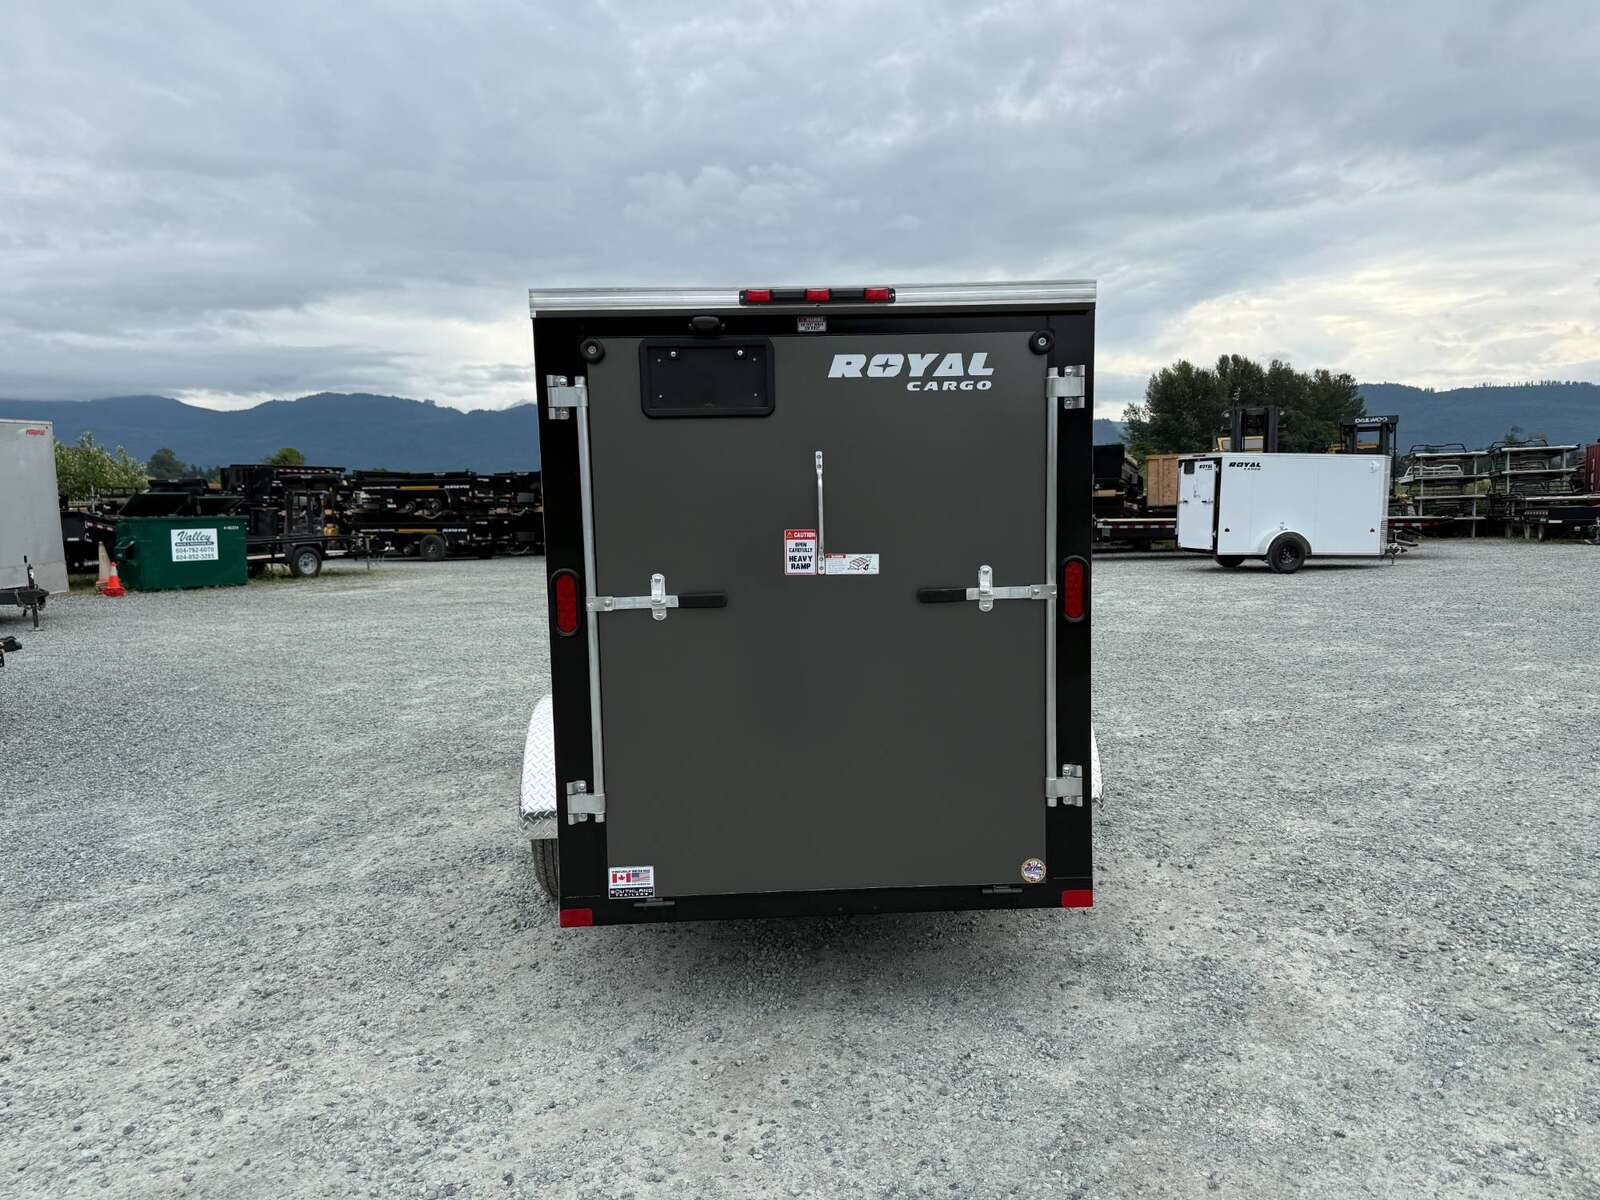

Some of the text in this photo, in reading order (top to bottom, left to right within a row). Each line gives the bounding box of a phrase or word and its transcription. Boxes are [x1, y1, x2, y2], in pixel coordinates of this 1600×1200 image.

[828, 352, 994, 378] ROYAL
[907, 380, 992, 391] CARGO
[1354, 416, 1388, 424] DAEWOO
[176, 531, 212, 542] Valley
